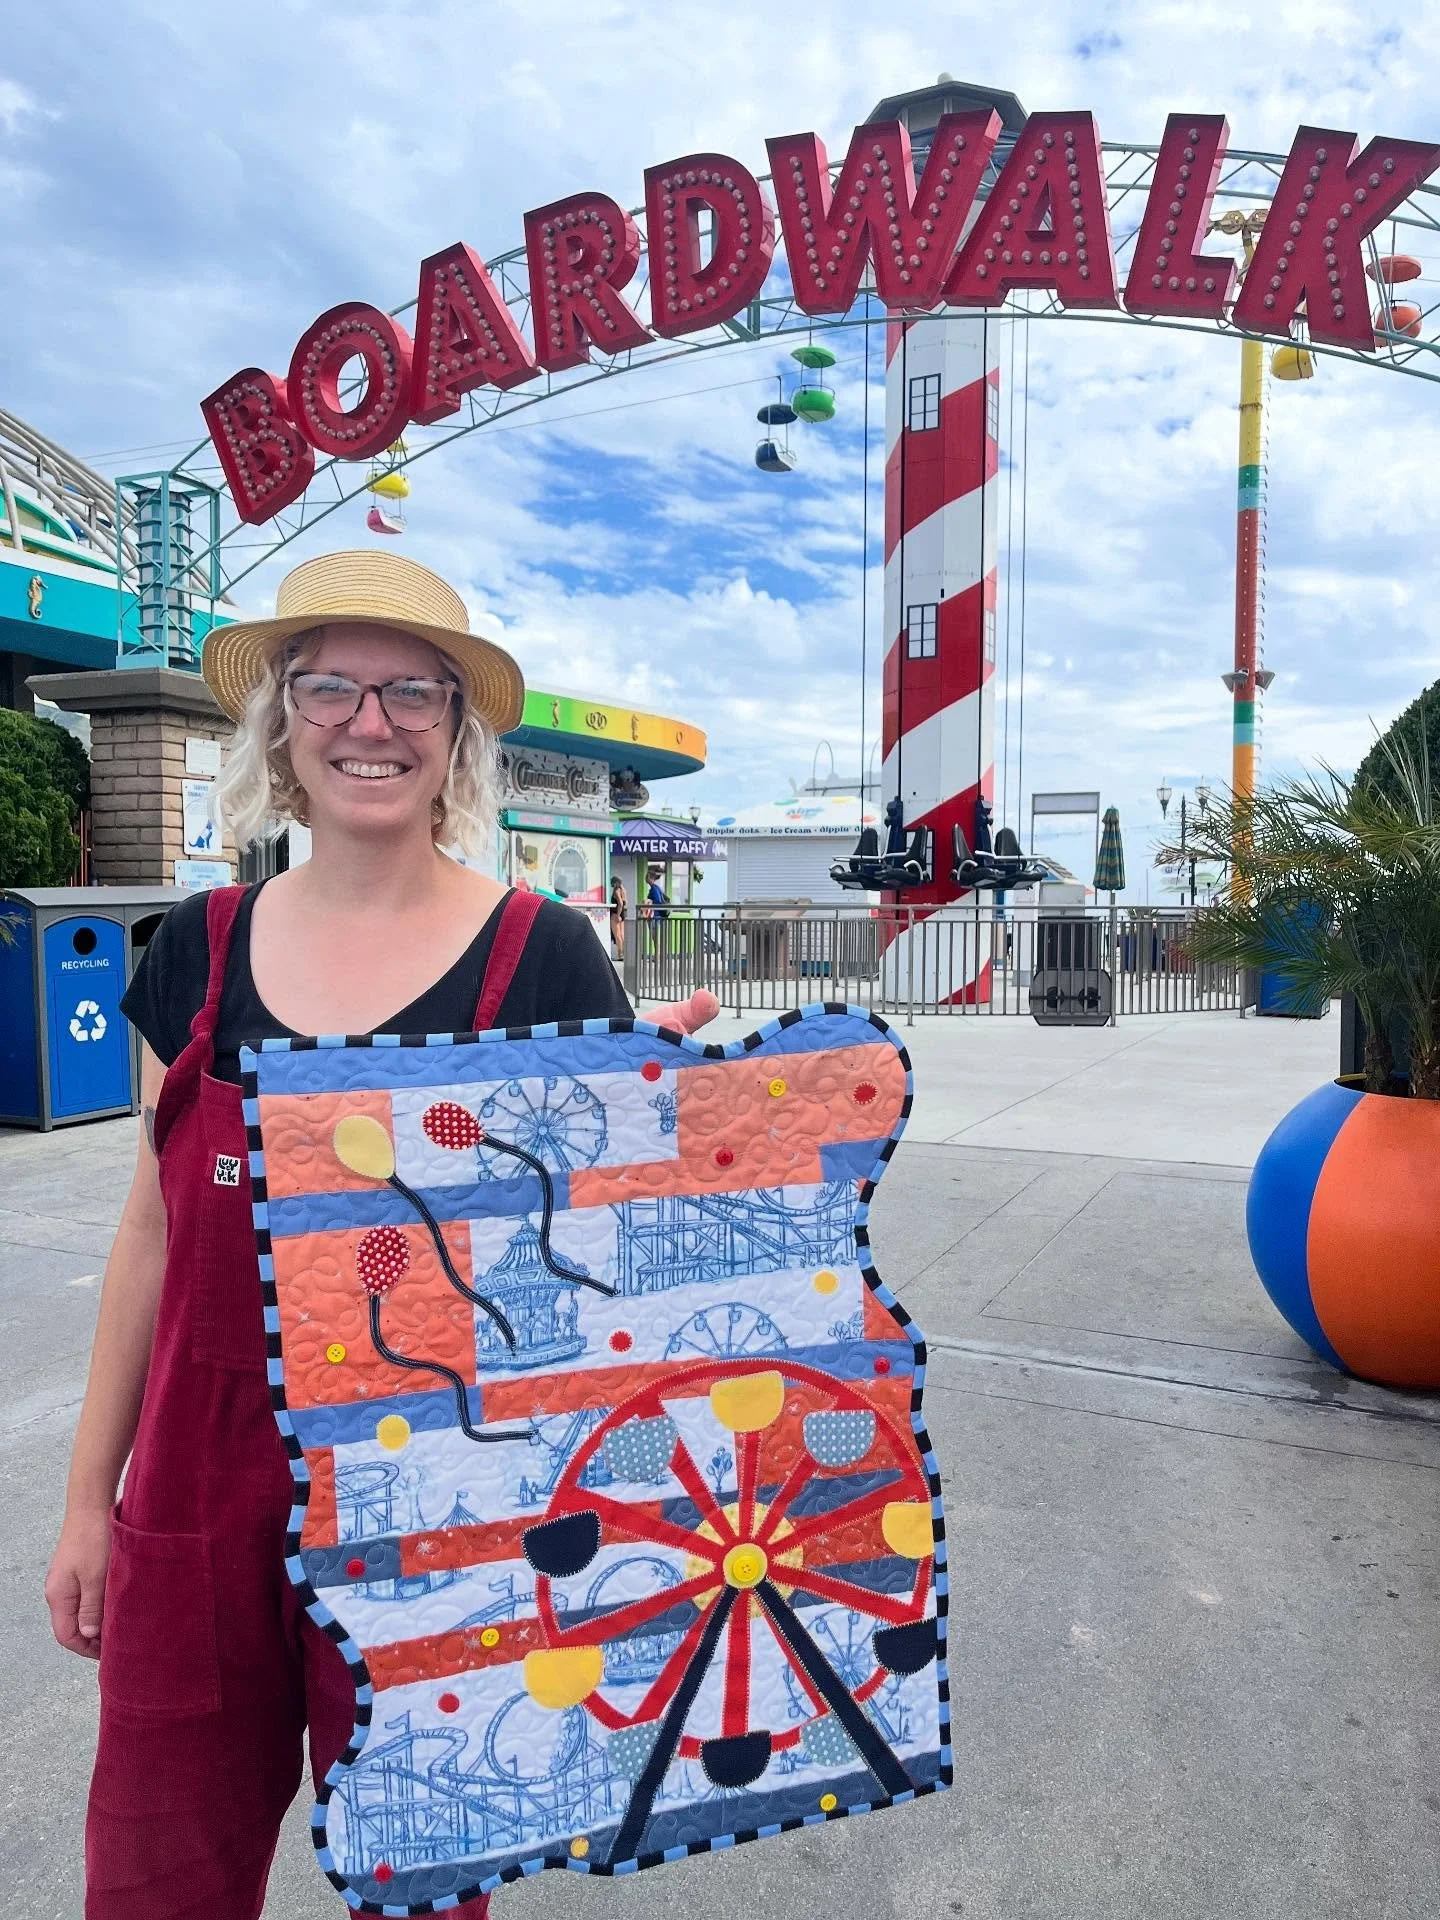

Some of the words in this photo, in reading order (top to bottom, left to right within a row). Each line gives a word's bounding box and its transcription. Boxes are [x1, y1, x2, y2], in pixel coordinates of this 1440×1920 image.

[201, 109, 1440, 525] BOARDWALK
[620, 839, 669, 853] WATER
[673, 840, 708, 855] TAFFY
[61, 958, 110, 970] RECYCLING
